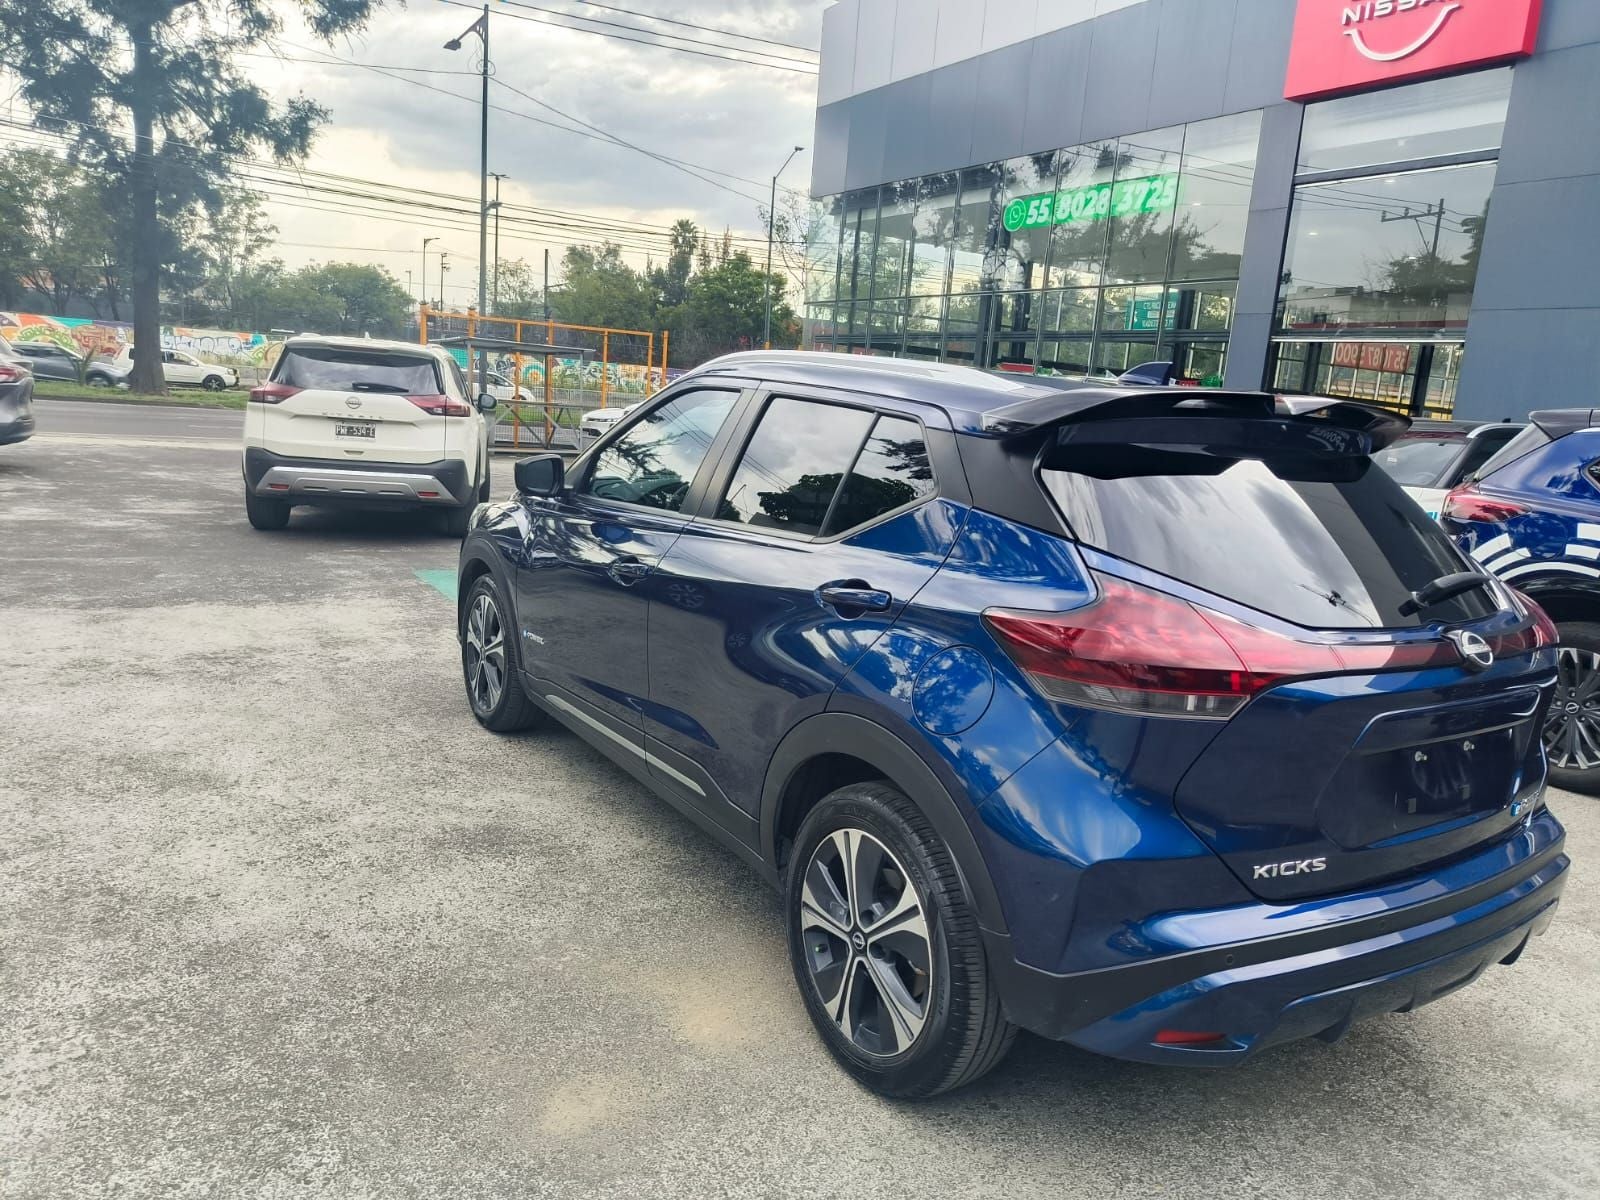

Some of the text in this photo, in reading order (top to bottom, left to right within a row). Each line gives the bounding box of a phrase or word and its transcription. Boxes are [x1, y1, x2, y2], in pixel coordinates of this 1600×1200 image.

[1026, 178, 1177, 225] 55 8028 3725
[1253, 857, 1327, 880] KICKS
